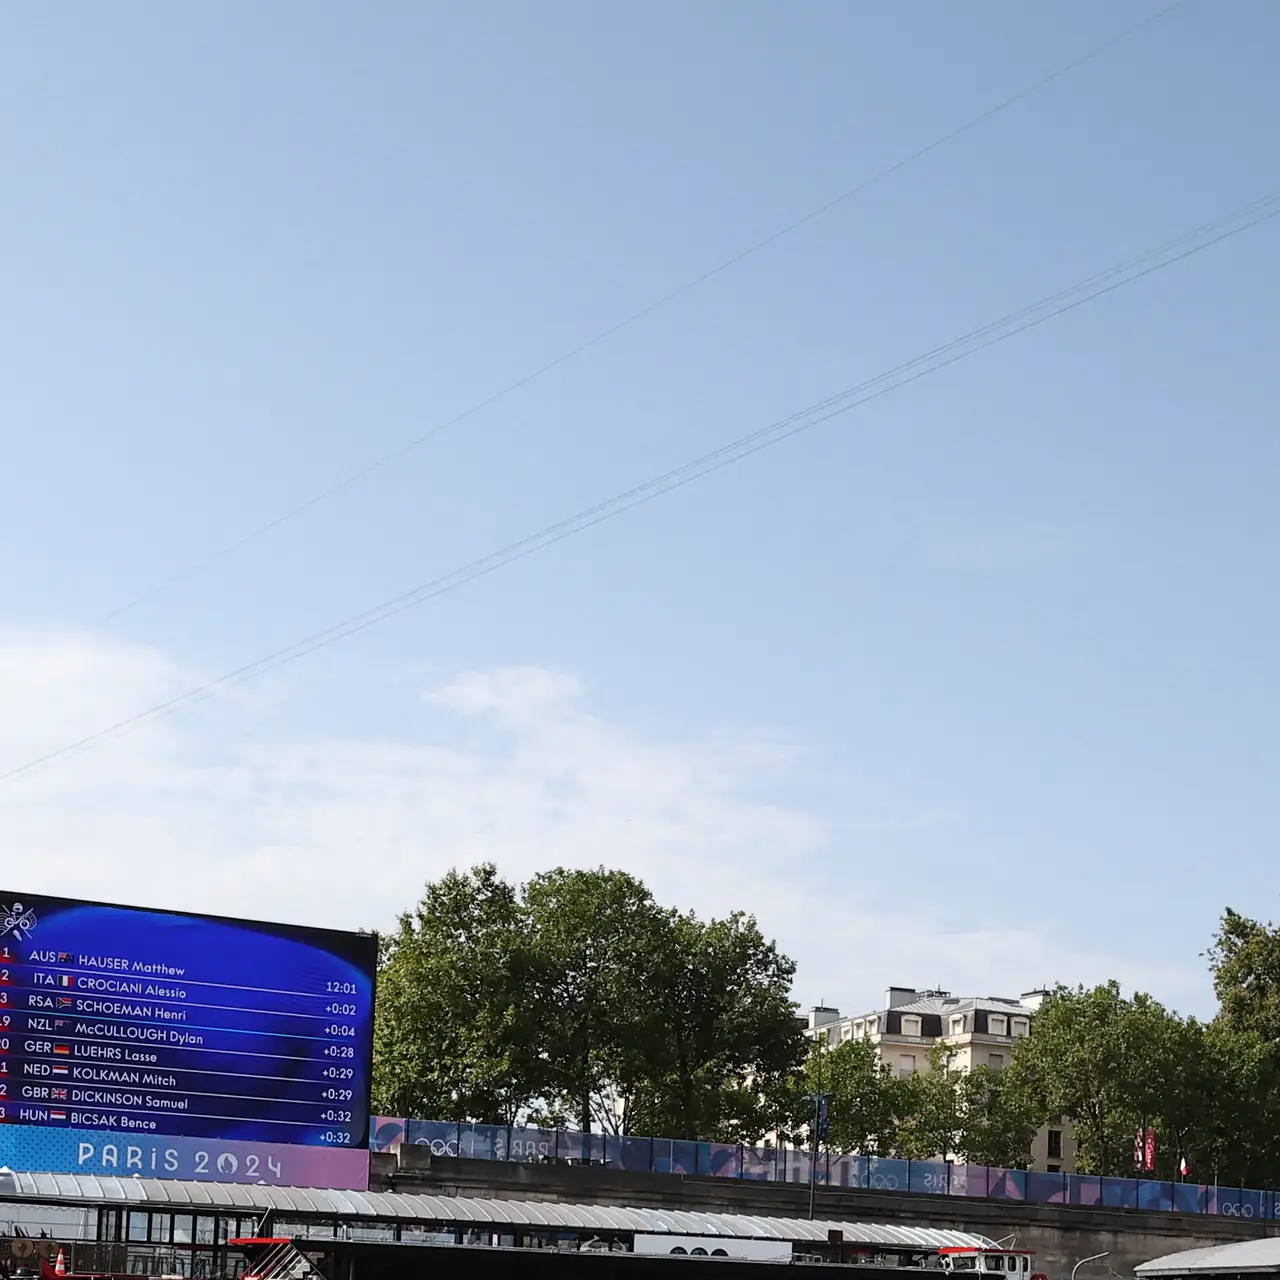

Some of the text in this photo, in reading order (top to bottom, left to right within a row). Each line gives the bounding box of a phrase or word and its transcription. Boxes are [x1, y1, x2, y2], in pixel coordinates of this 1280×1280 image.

[3, 947, 357, 994] 1 AUS HAUSER Matthew 12:01
[1, 969, 356, 1015] 2 ITA CROCIANI Alessio +0:02
[0, 992, 355, 1036] 3 RSA SCHOEMAN Henri +0:04
[28, 1019, 52, 1031] NZL
[75, 1022, 166, 1041] McCULLOUGH
[170, 1031, 203, 1045] Dylan
[324, 1046, 354, 1058] +0:28
[24, 1041, 51, 1054] GER
[74, 1045, 121, 1059] LUEHRS
[125, 1050, 157, 1063] Lasse
[322, 1067, 353, 1079] +0:29
[23, 1064, 50, 1076] NED
[73, 1067, 139, 1083] KOLKMAN
[142, 1074, 176, 1087] Mitch
[321, 1089, 352, 1101] +0:29
[22, 1087, 49, 1099] GBR
[72, 1090, 143, 1106] DICKINSON
[145, 1096, 188, 1109] Samuel
[320, 1110, 351, 1122] +0:32
[20, 1109, 48, 1121] HUN
[71, 1113, 117, 1126] BICSAK
[121, 1117, 157, 1130] Bence
[320, 1131, 351, 1143] +0:32
[78, 1142, 282, 1178] PARIS 2024
